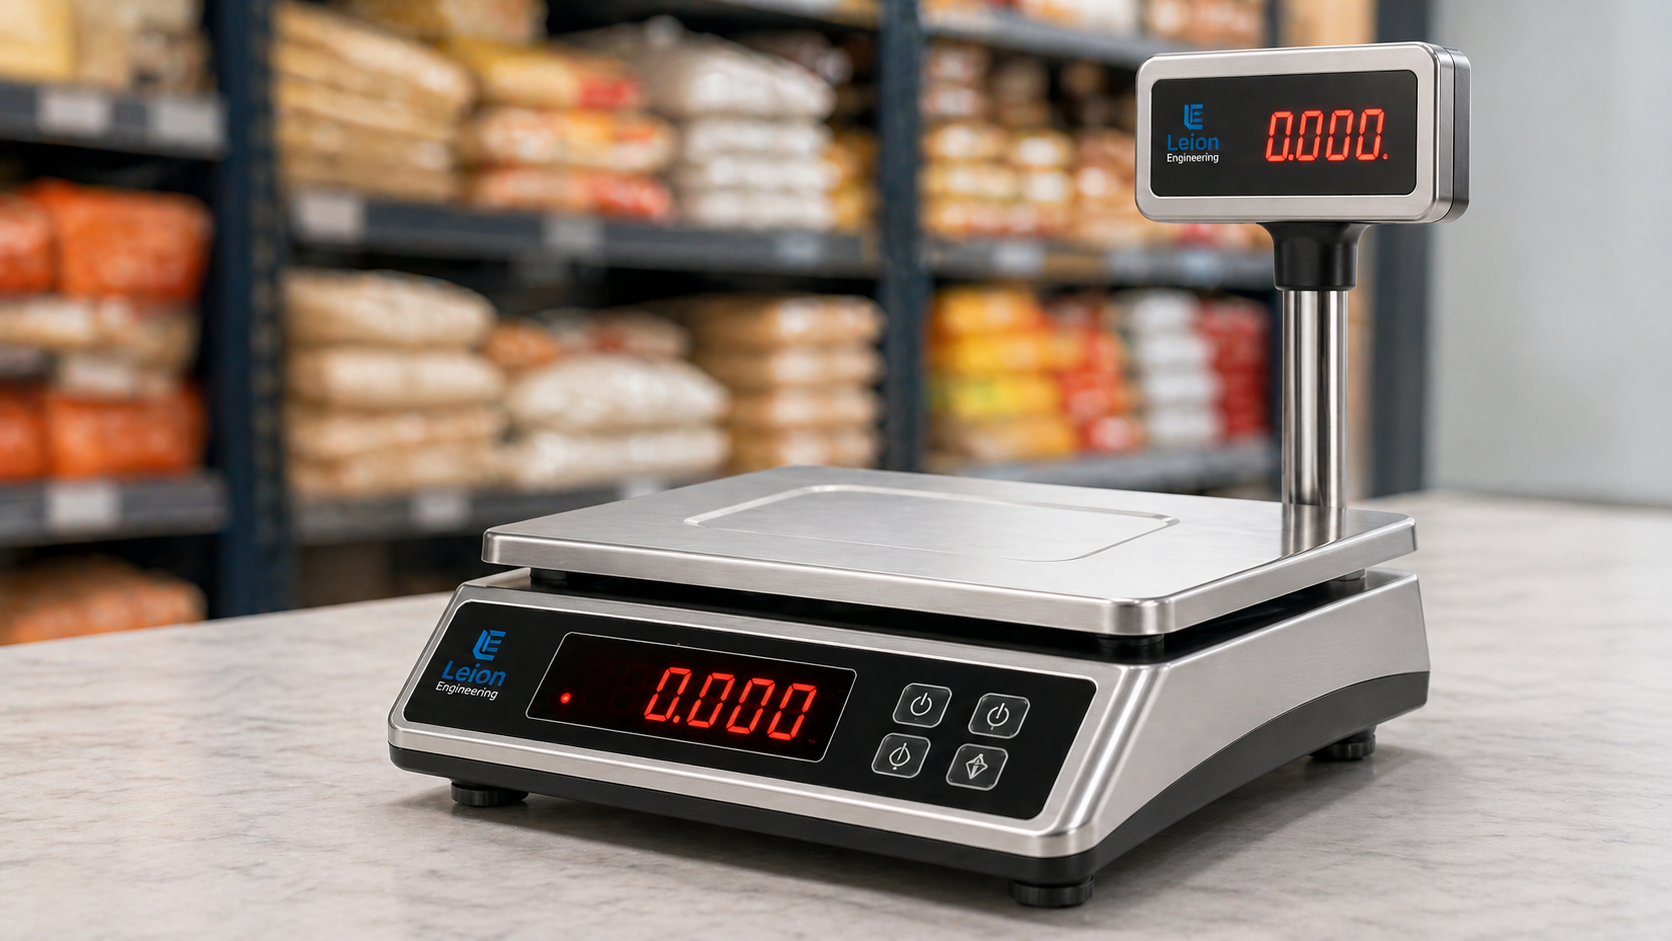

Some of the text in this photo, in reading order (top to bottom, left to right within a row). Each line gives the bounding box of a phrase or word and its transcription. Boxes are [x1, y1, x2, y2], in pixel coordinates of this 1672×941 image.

[1167, 133, 1219, 151] Leion
[1167, 153, 1219, 164] Engineering
[441, 660, 507, 687] Leion
[435, 681, 499, 701] Engineering
[644, 667, 817, 741] 0.000
